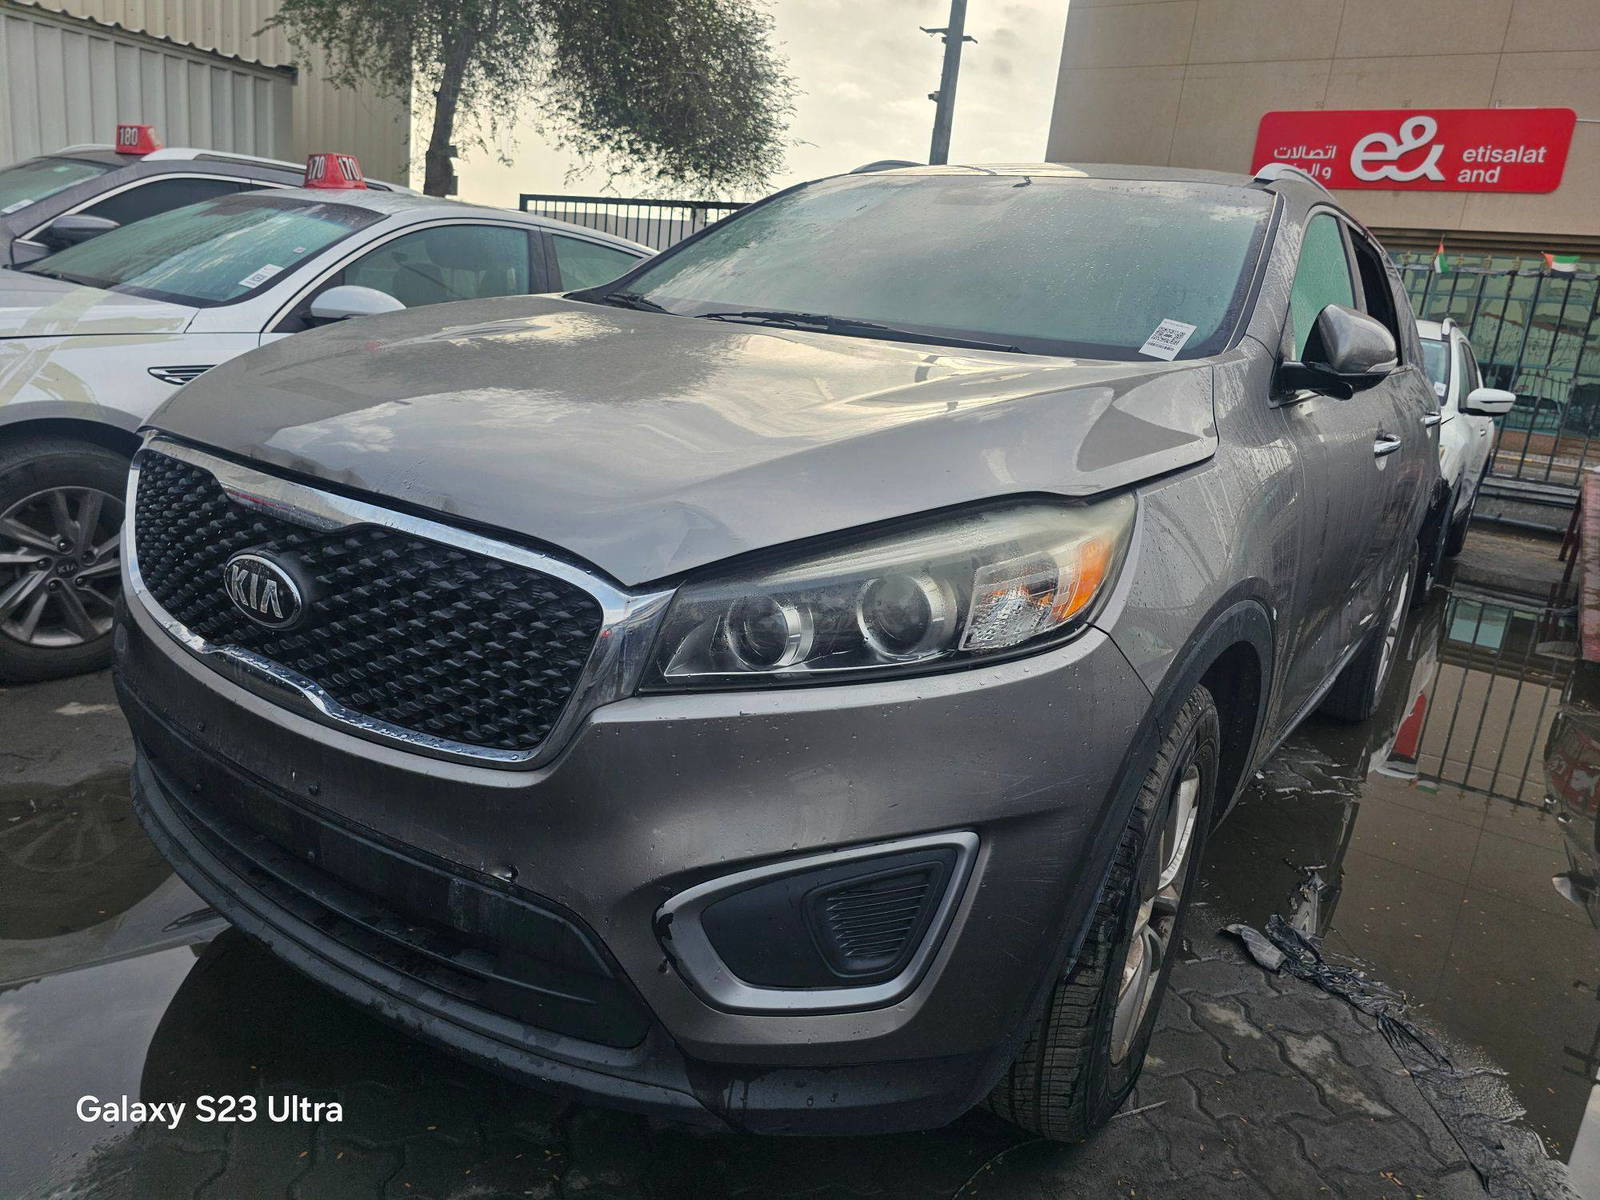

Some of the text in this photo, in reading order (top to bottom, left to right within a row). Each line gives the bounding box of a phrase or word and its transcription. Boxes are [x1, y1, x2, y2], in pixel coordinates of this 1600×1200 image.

[119, 127, 138, 146] 180
[1273, 145, 1337, 159] اتصالات
[1462, 145, 1547, 163] etisalat
[308, 156, 326, 180] 170
[338, 156, 361, 181] 170
[1457, 166, 1501, 183] and
[231, 564, 284, 619] KIA
